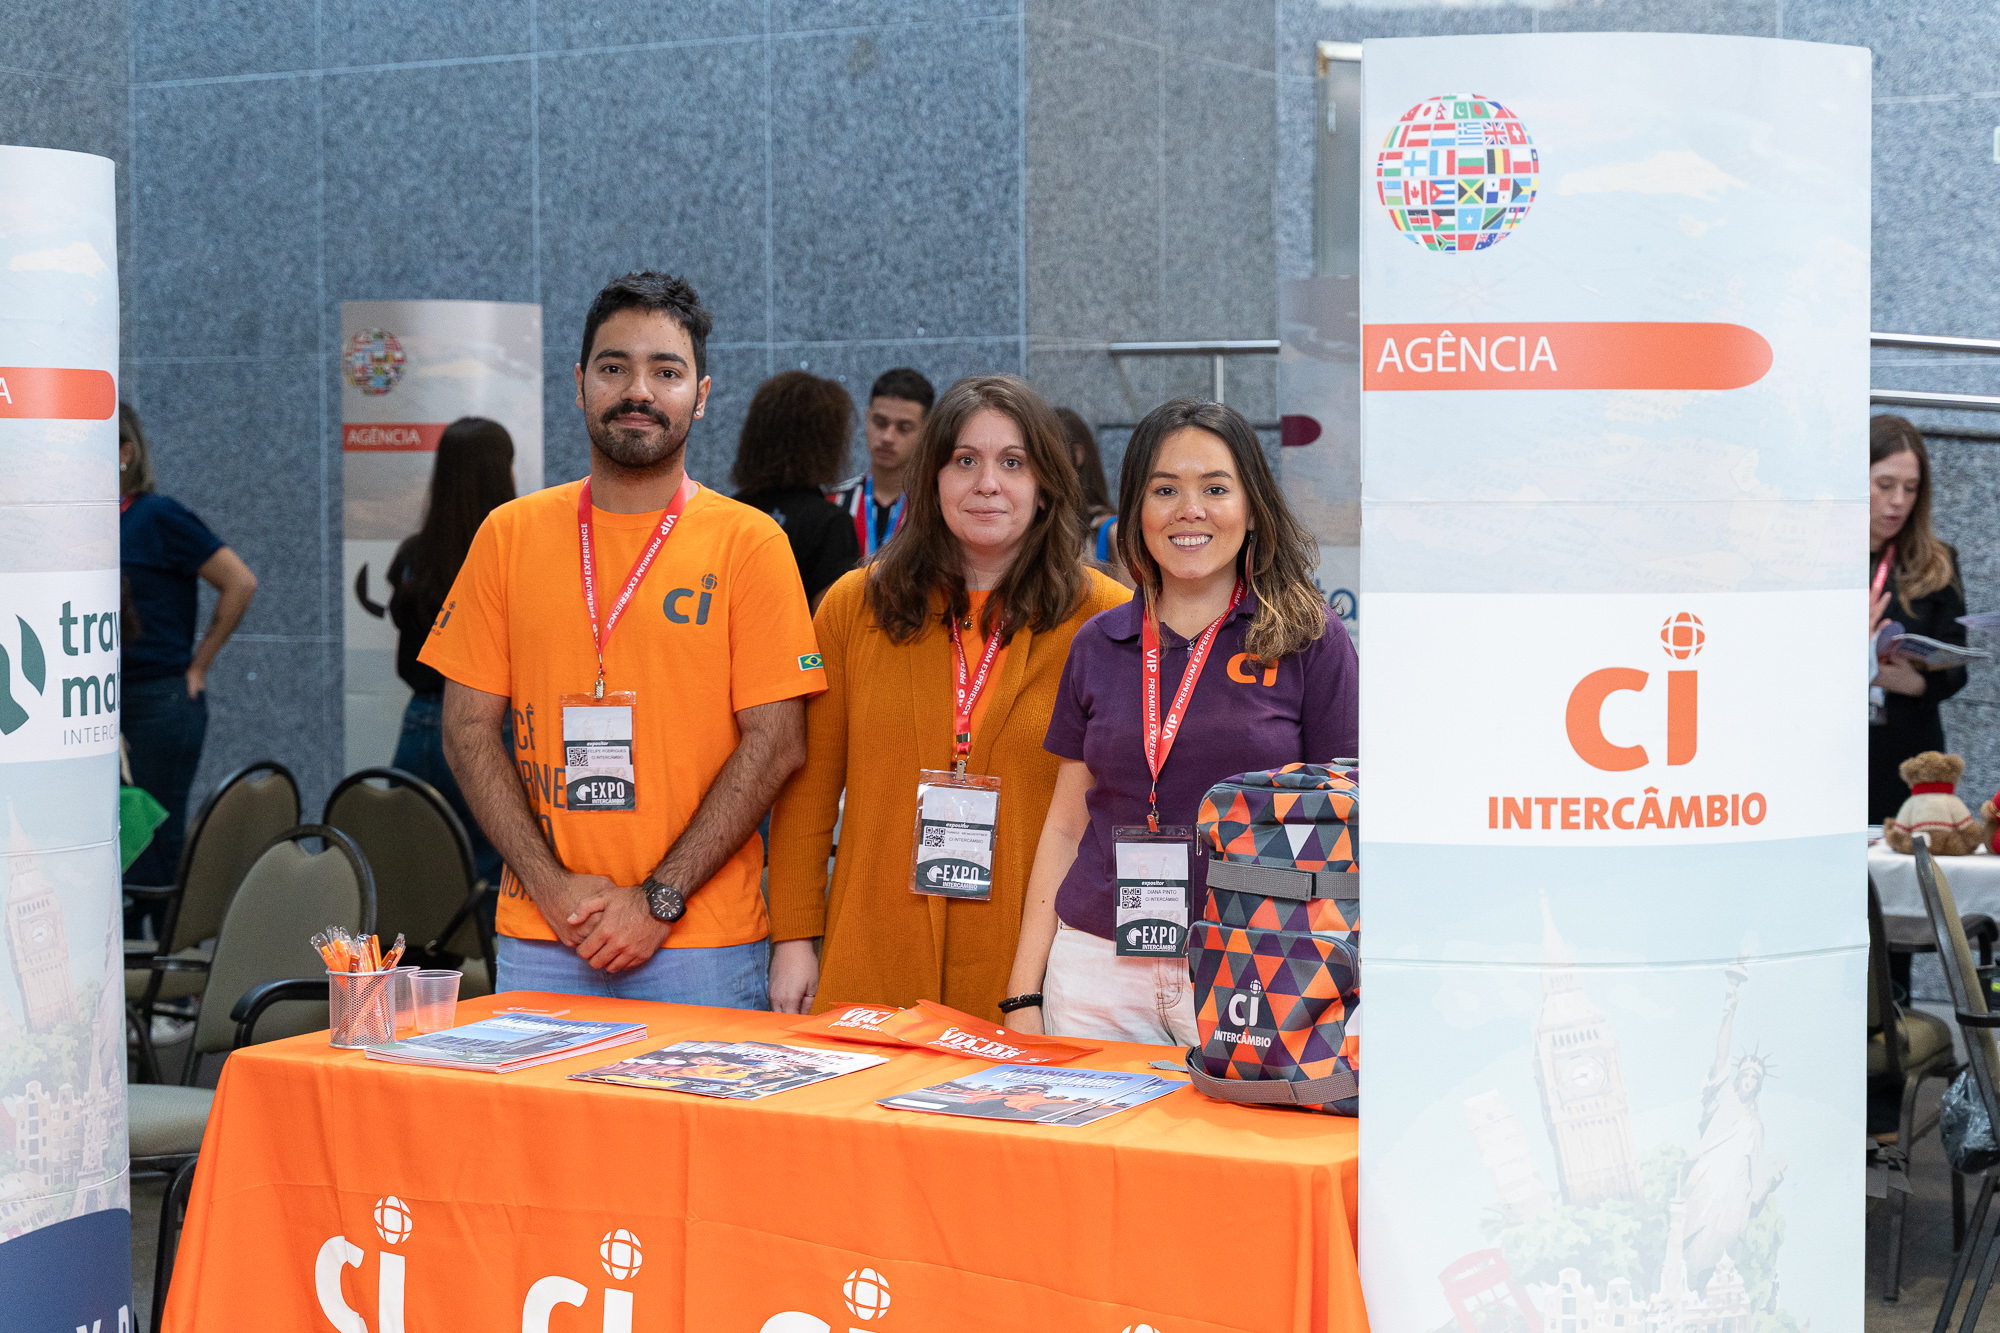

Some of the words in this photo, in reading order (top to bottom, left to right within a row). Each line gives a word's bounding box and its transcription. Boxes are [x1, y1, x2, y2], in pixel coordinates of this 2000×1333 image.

[1377, 330, 1557, 373] AGÊNCIA
[347, 427, 421, 446] AGÊNCIA
[660, 513, 678, 536] VIP
[581, 523, 592, 575] EXPERIENCE
[635, 537, 662, 579] PREMIUM
[586, 576, 597, 619] PREMIUM
[606, 577, 639, 631] EXPERIENCE
[1146, 648, 1157, 673] VIP
[961, 663, 989, 716] EXPERIENCE
[1147, 677, 1156, 722] PREMIUM
[1162, 713, 1179, 740] VIP
[1175, 663, 1198, 710] PREMIUM
[591, 781, 625, 799] EXPO
[1488, 786, 1767, 830] INTERCÂMBIO
[943, 864, 979, 882] EXPO
[1142, 926, 1176, 945] EXPO
[938, 1029, 1021, 1059] VIAJAR
[1213, 1029, 1272, 1048] INTERCÂMBIO
[1009, 1067, 1097, 1080] MANUAL
